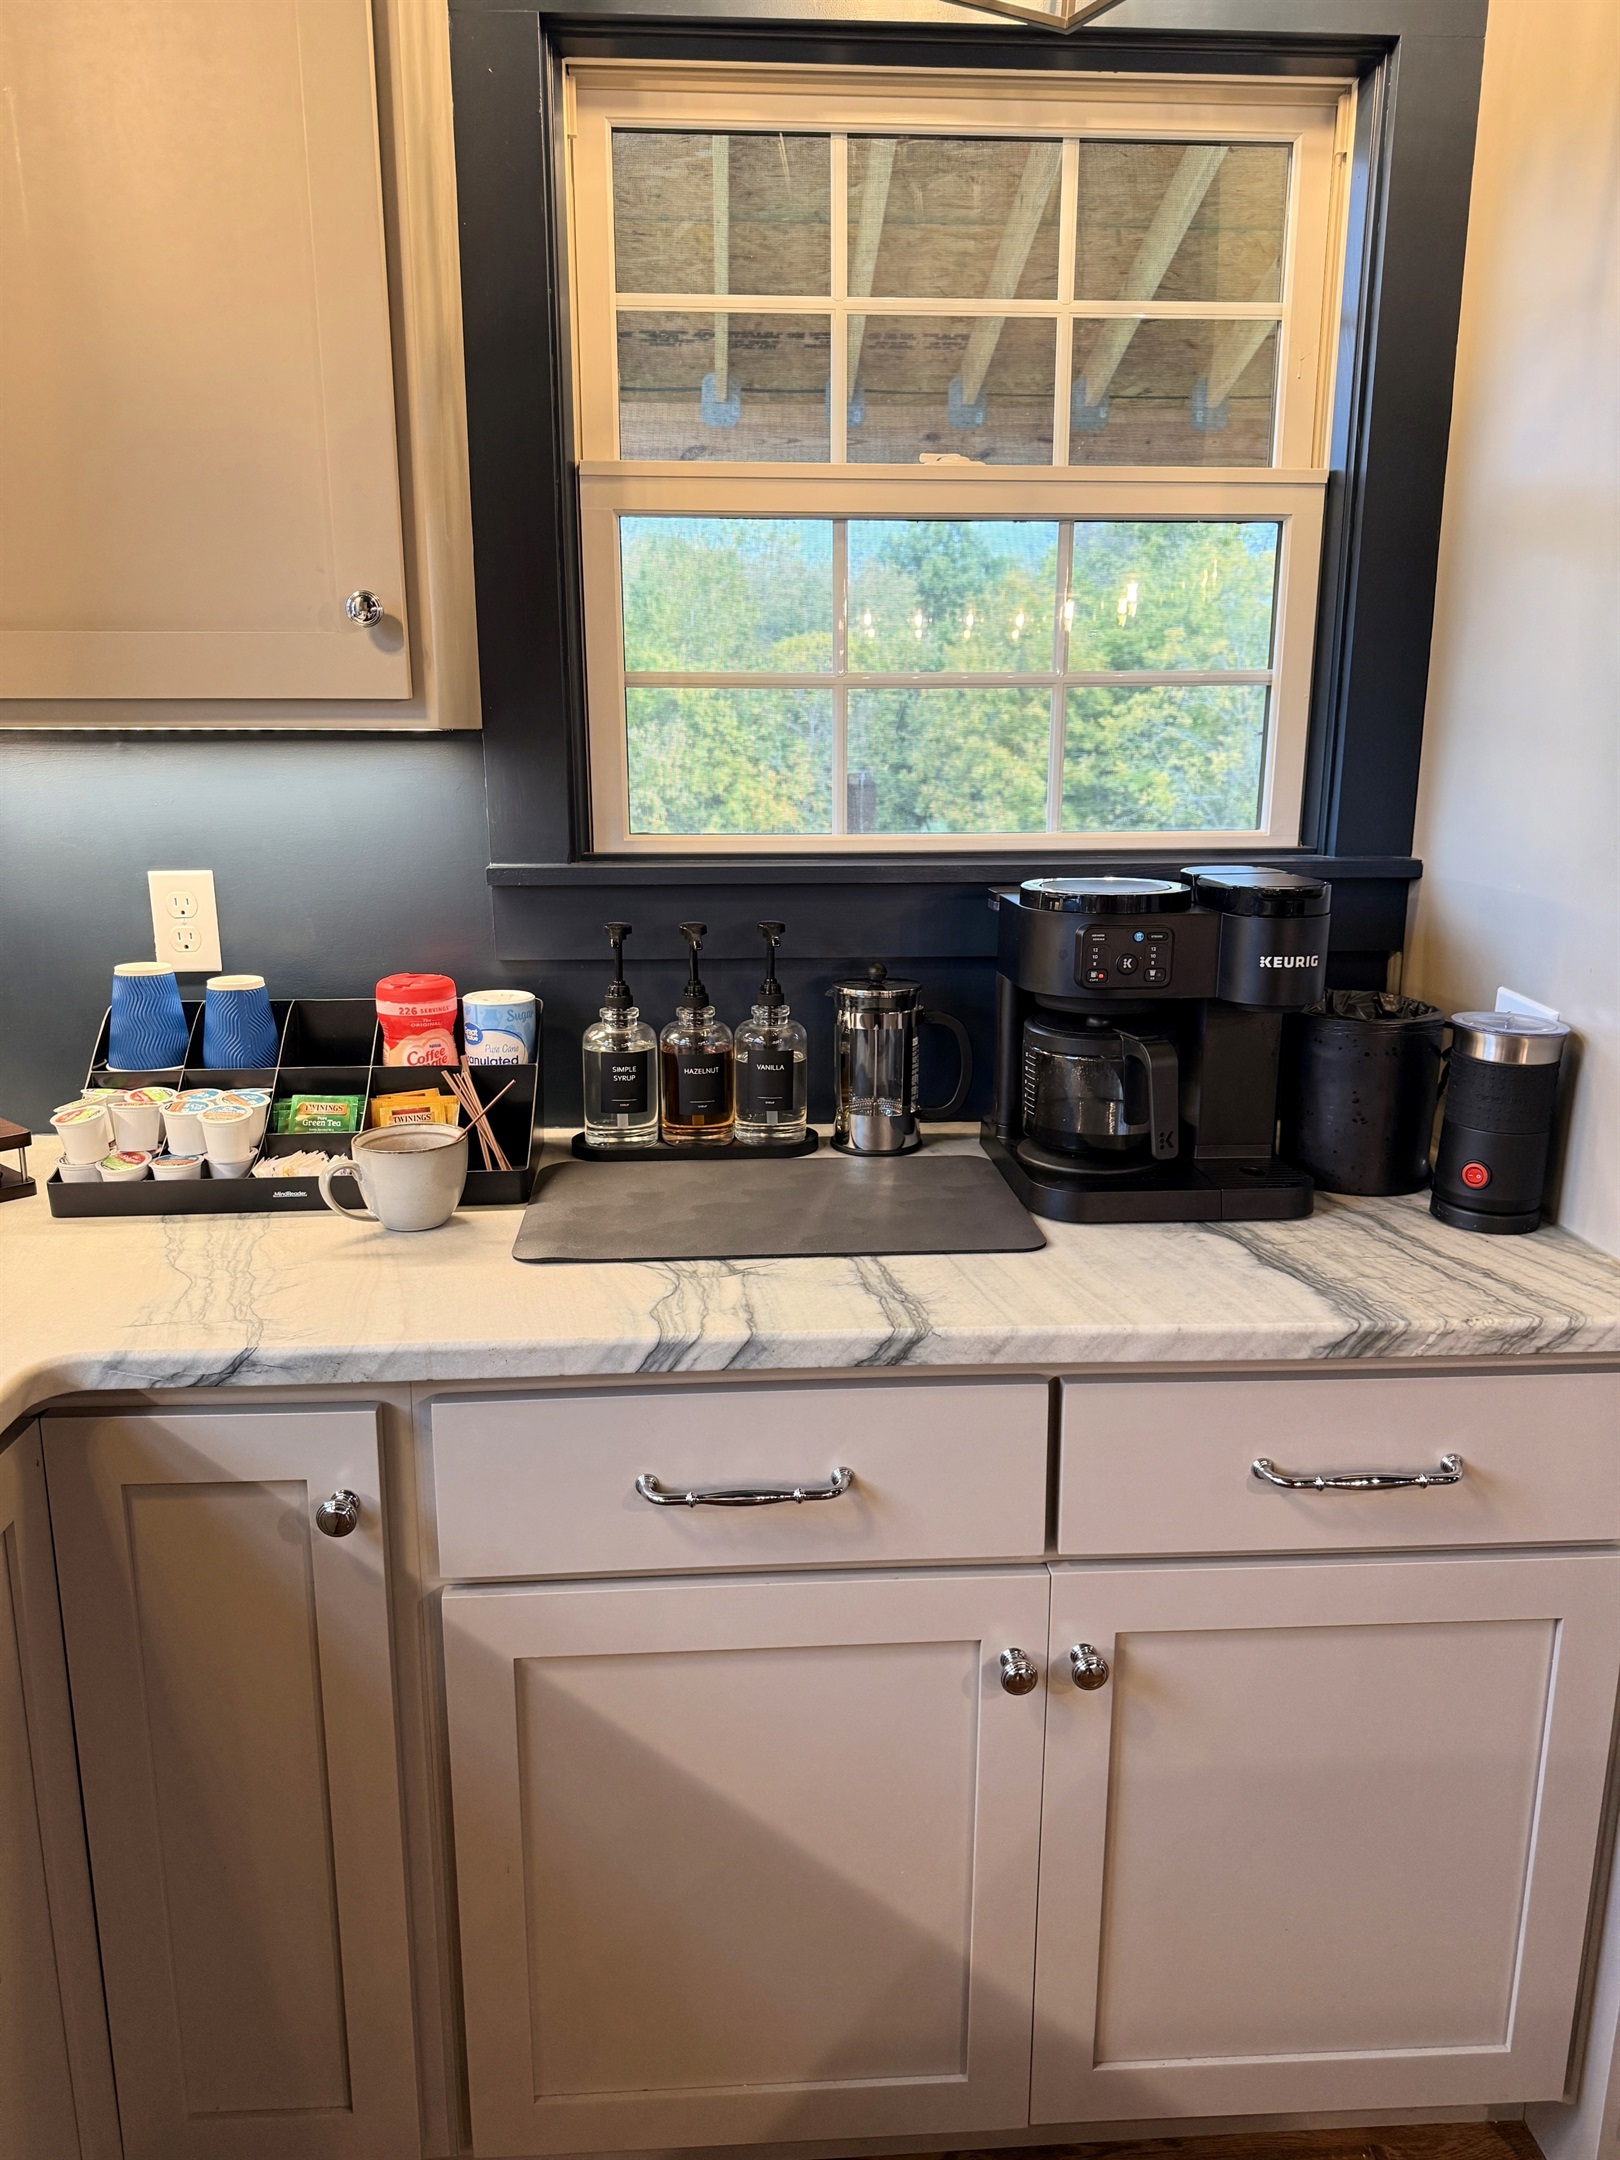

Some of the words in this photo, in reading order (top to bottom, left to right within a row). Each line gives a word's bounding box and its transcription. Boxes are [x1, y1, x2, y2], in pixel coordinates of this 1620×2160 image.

[1259, 955, 1319, 968] KEURIG
[398, 1007, 418, 1016] 226
[420, 1006, 450, 1014] SERVINGS
[506, 1009, 534, 1022] Sugar
[406, 1047, 446, 1066] Coffee
[467, 1055, 519, 1065] anulated
[611, 1065, 637, 1073] SIMPLE
[683, 1066, 719, 1075] HAZELNUT
[613, 1074, 636, 1082] SYRUP
[304, 1103, 344, 1112] TWININGS
[302, 1119, 326, 1127] Green
[327, 1119, 342, 1127] Tea
[393, 1113, 431, 1124] TWININGS
